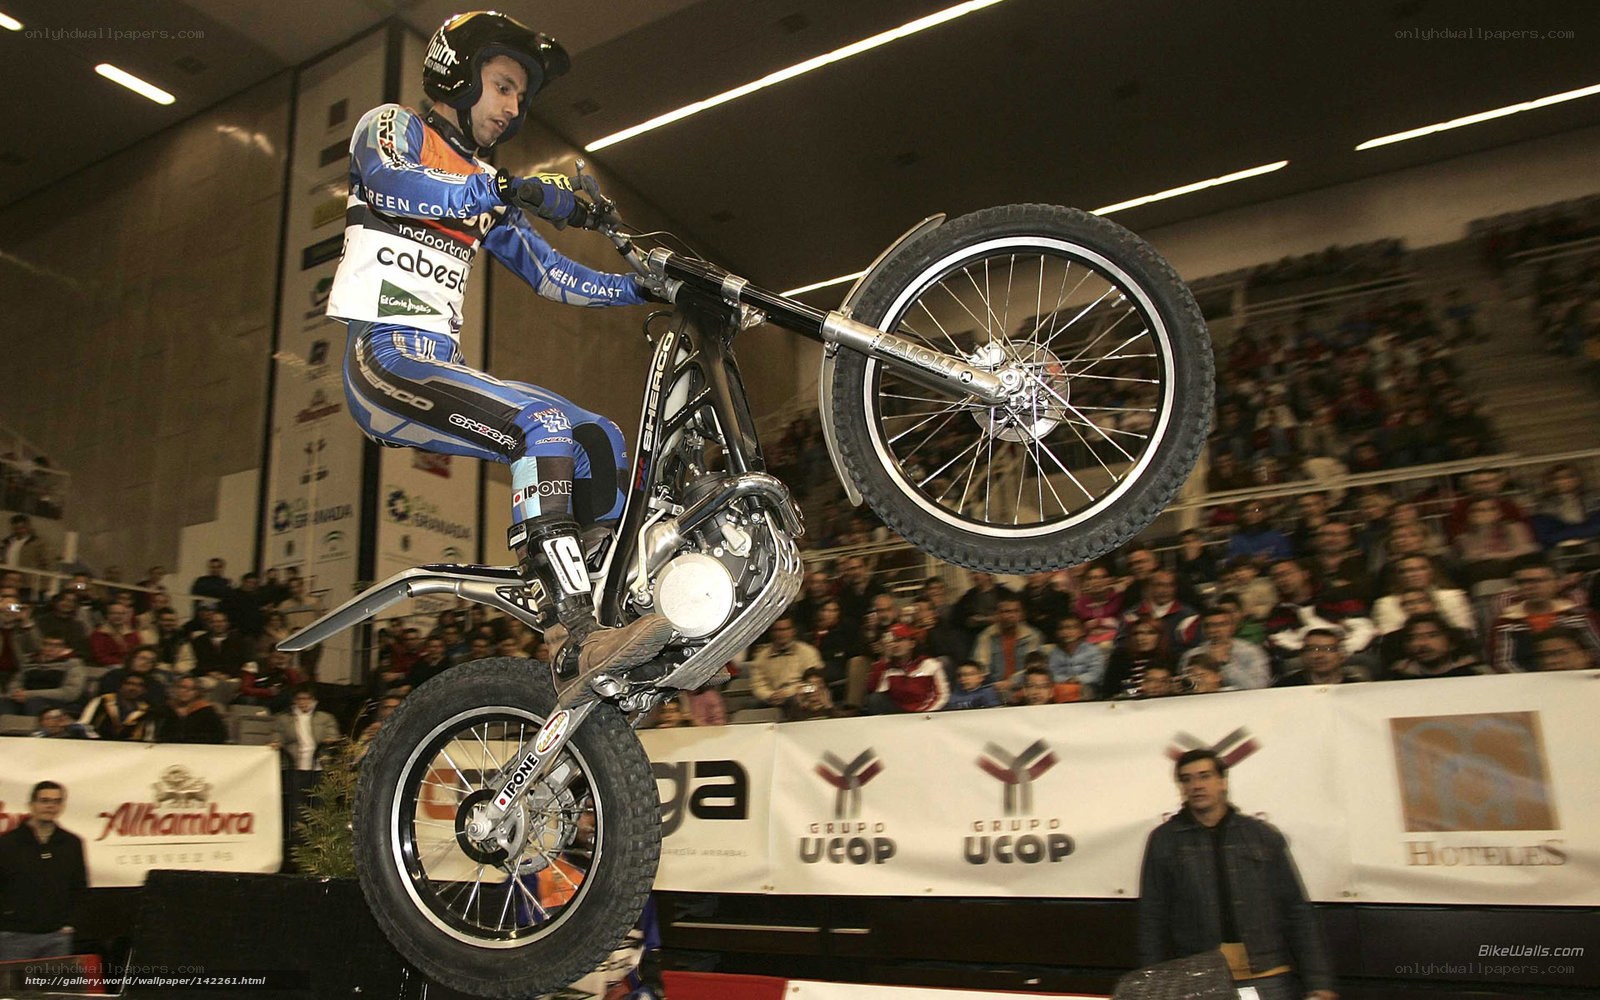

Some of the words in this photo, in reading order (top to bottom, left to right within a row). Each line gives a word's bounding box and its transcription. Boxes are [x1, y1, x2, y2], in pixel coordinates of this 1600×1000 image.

[581, 281, 622, 298] COAST
[877, 335, 957, 375] PAIOLI
[643, 330, 675, 452] SHERCO
[523, 480, 573, 500] IPONE
[503, 753, 539, 800] IPONE
[94, 802, 255, 842] Alhambra
[810, 822, 885, 834] GRUPO
[973, 818, 1062, 832] GRUPO
[799, 837, 898, 865] UCOP
[963, 834, 1077, 865] UCOP
[1403, 838, 1567, 867] HOTELES
